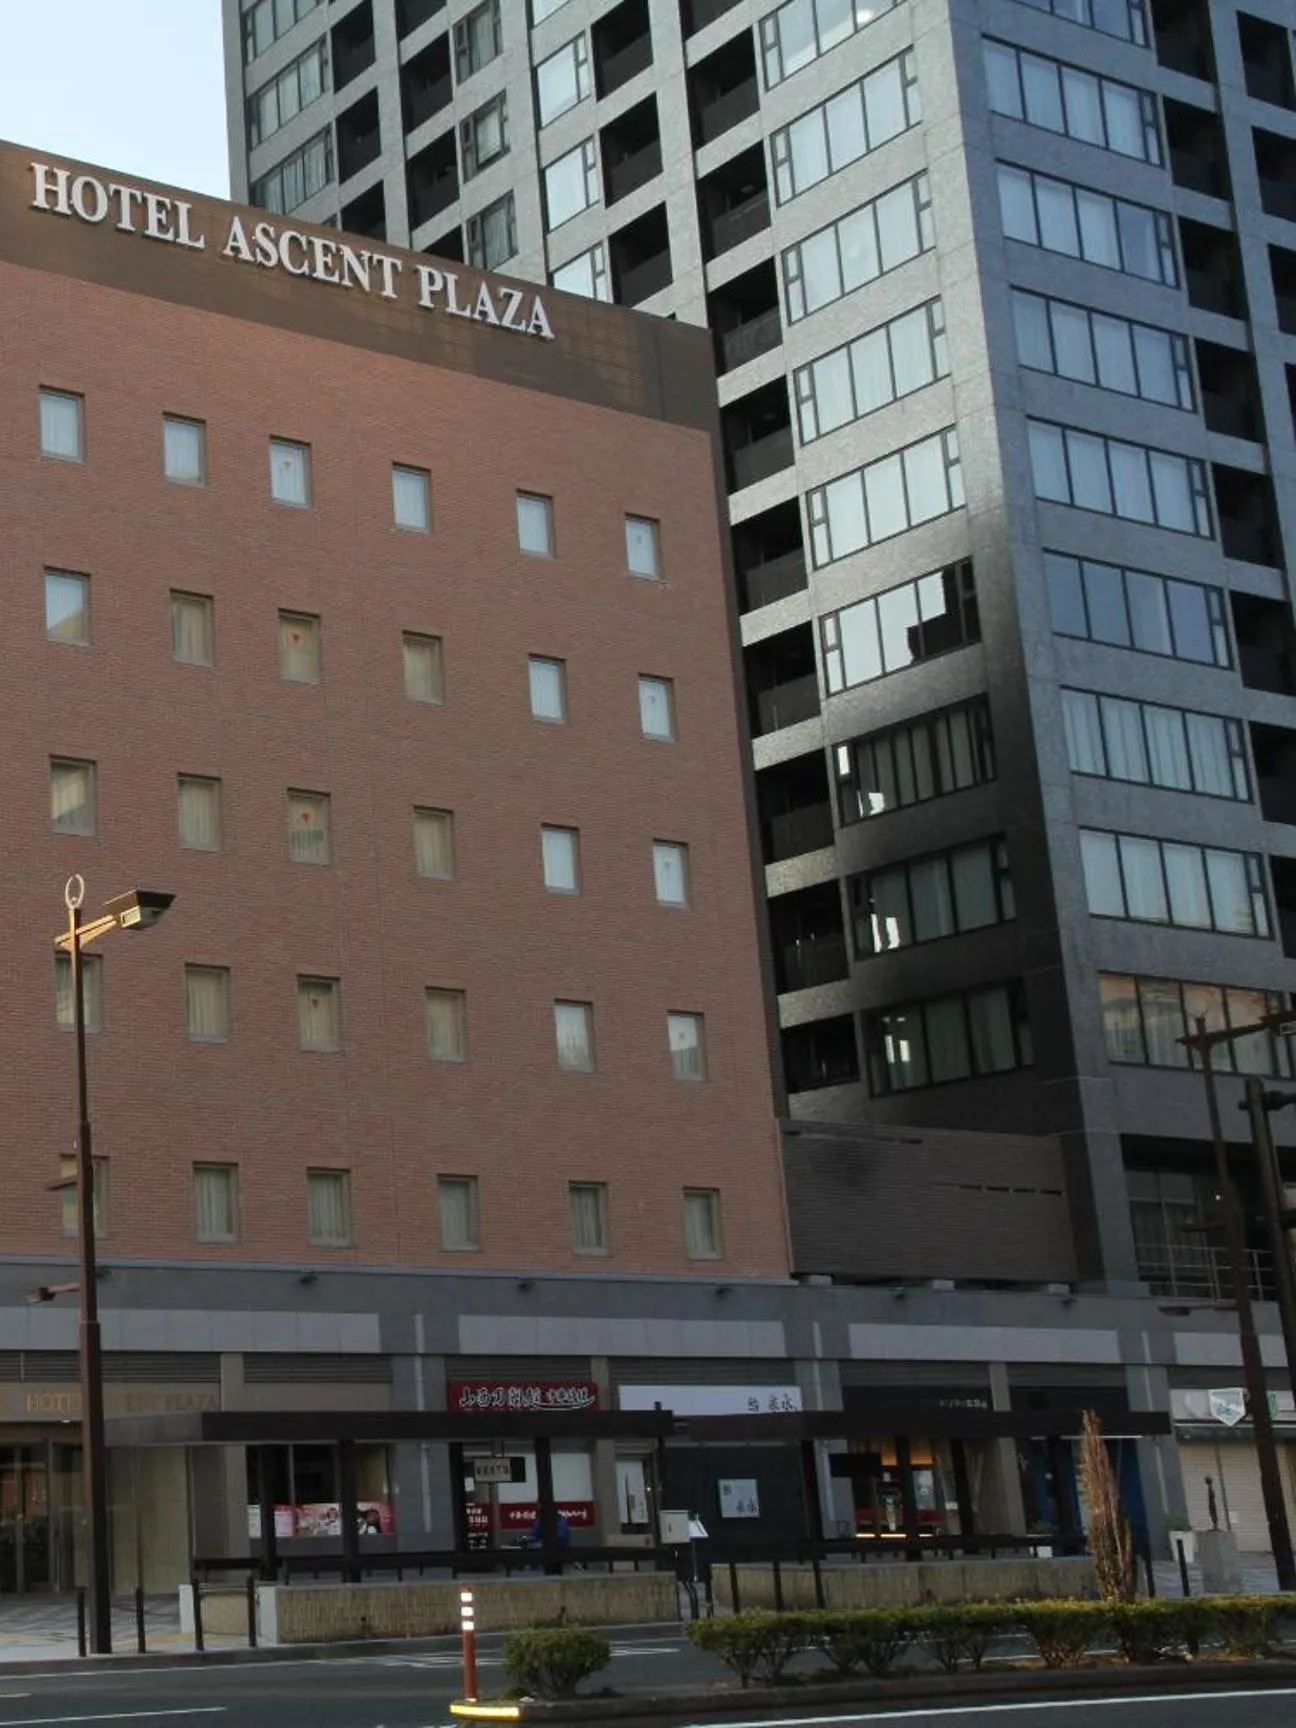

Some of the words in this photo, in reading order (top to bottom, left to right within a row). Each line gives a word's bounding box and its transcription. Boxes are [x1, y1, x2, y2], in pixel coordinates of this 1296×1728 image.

[30, 161, 205, 249] HOTEL
[222, 214, 402, 299] ASCENT
[415, 264, 556, 341] PLAZA
[26, 1392, 83, 1412] HOTE
